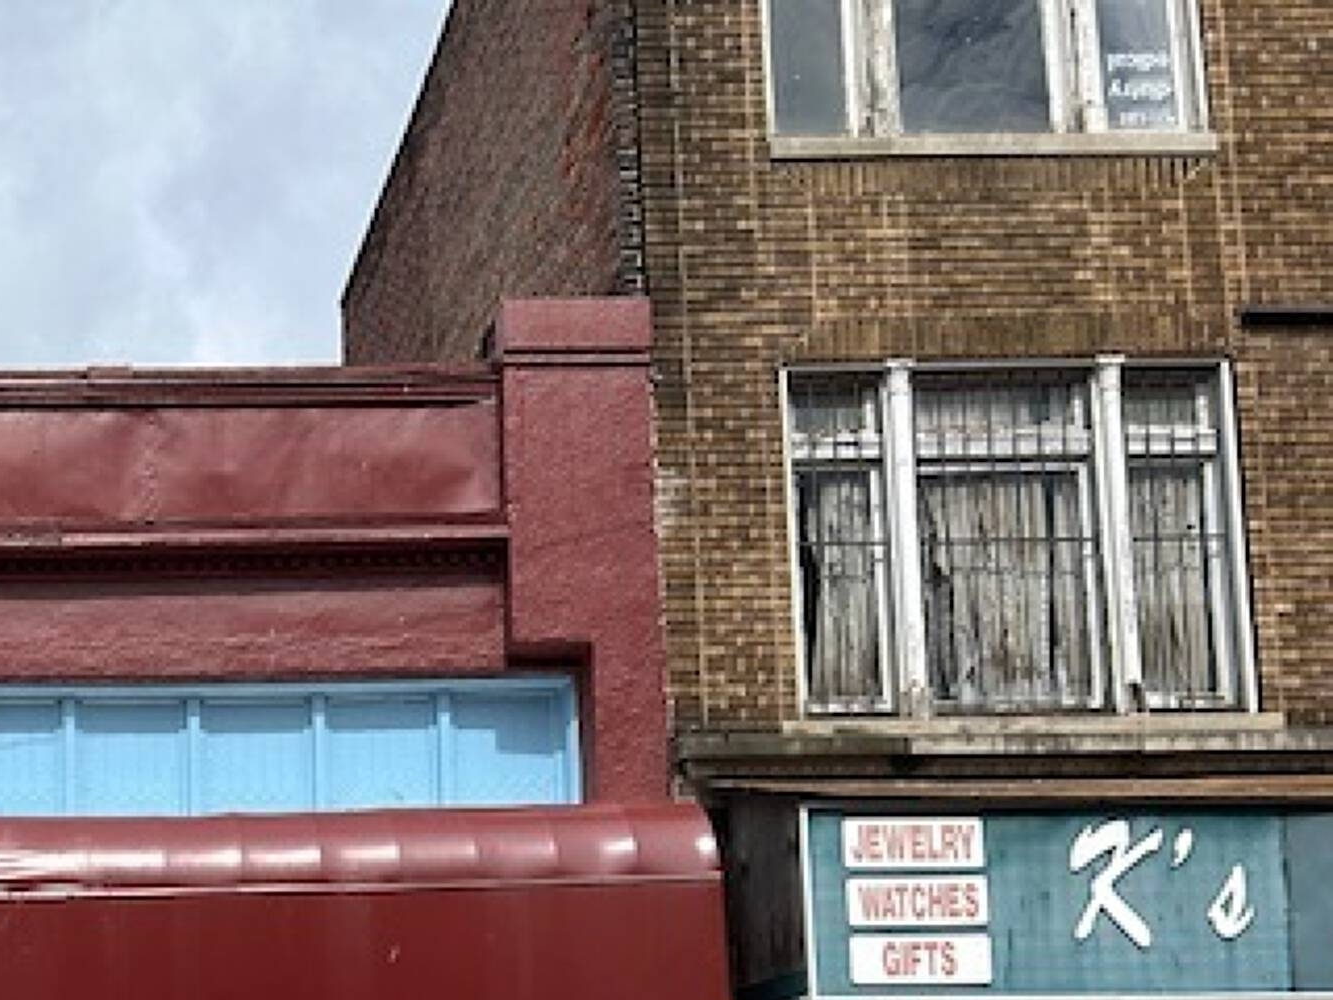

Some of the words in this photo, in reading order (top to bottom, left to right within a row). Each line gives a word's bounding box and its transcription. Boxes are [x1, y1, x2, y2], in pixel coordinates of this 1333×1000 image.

[852, 824, 976, 862] JEWELRY
[857, 883, 979, 920] WATCHES
[1069, 819, 1256, 949] K's
[882, 941, 958, 976] GIFTS
